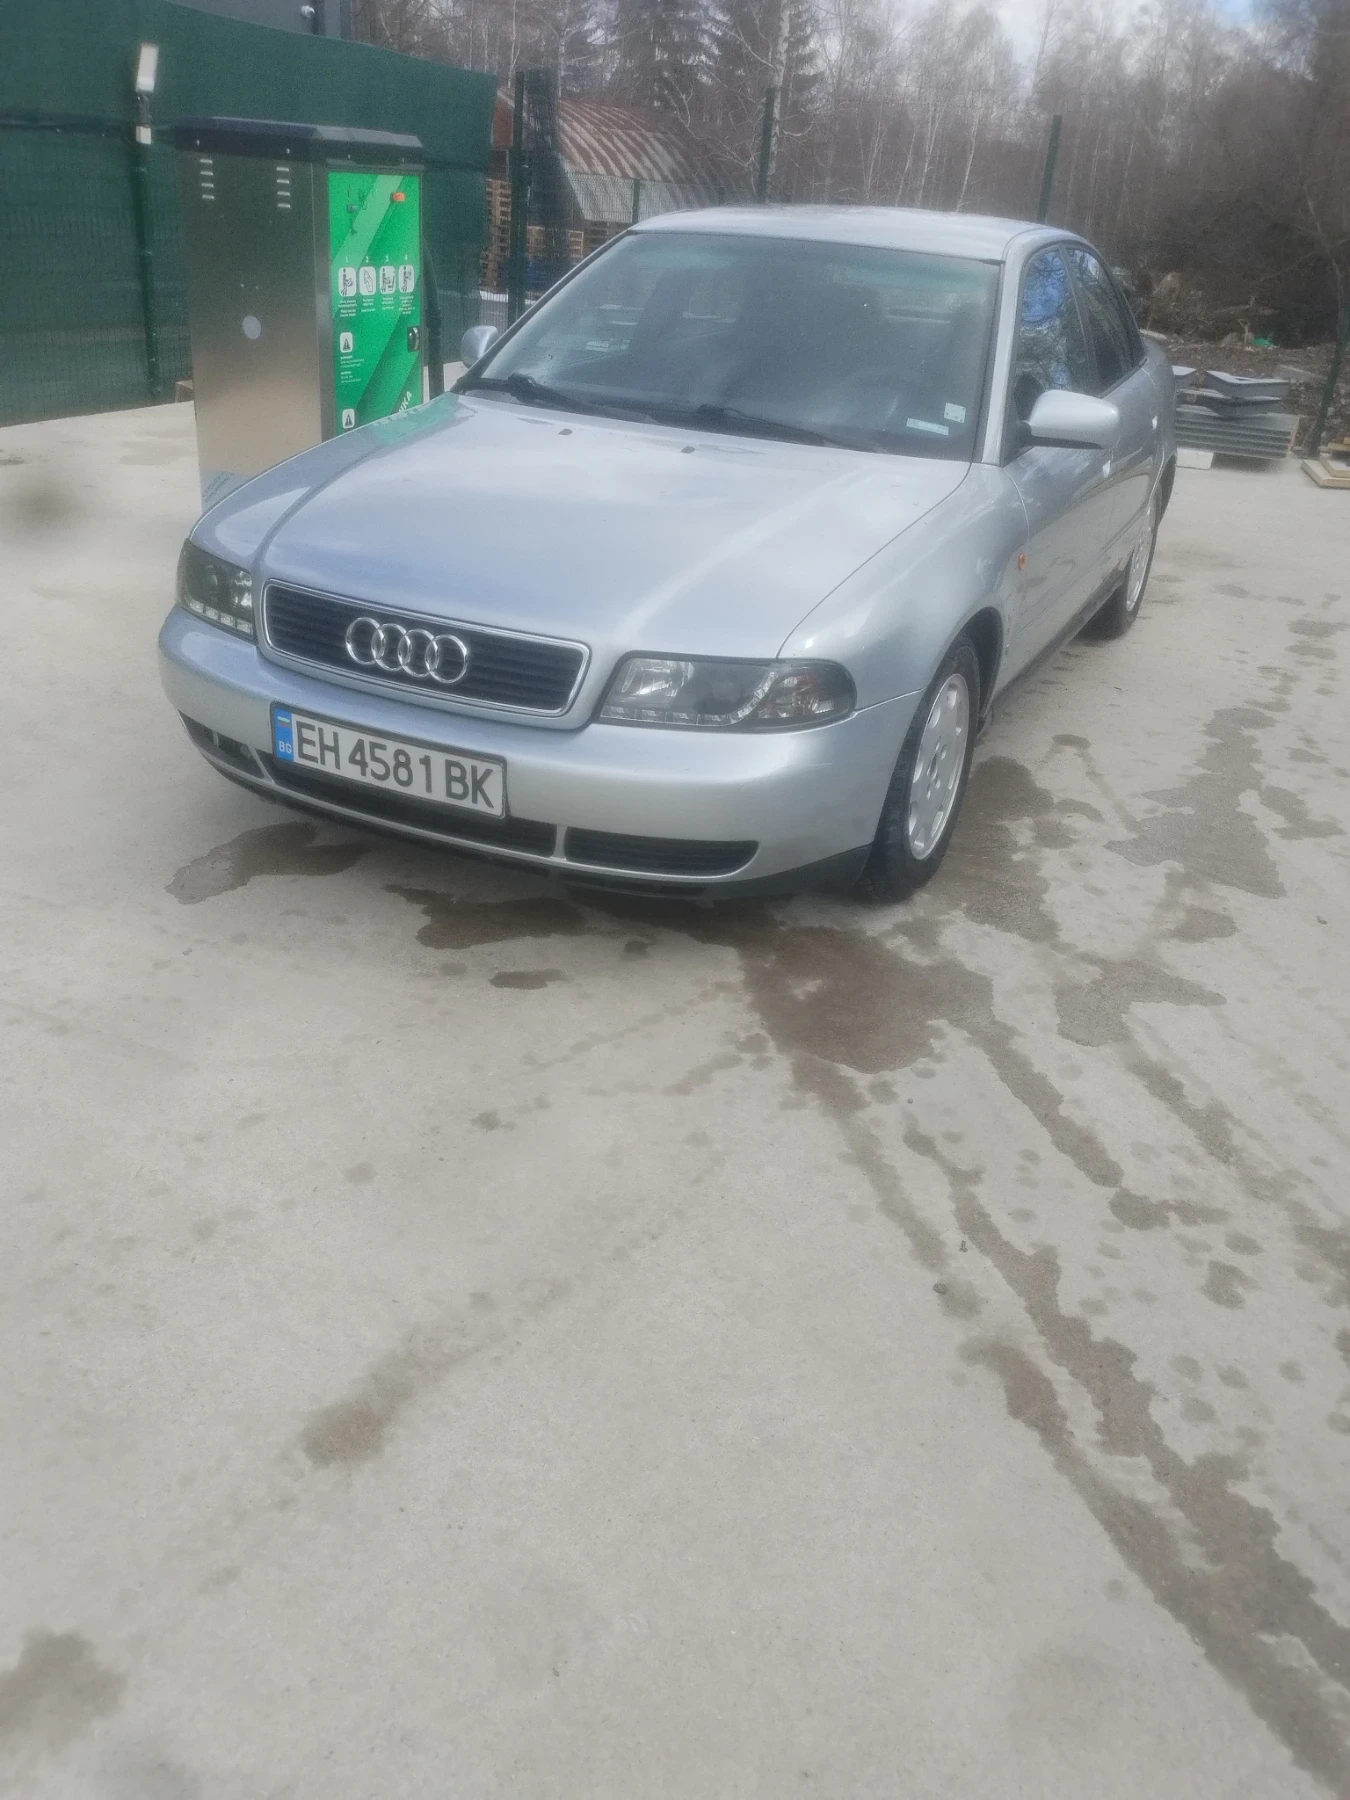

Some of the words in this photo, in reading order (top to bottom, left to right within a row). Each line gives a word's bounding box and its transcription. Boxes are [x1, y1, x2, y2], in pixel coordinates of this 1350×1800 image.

[278, 740, 292, 754] BG
[296, 720, 341, 770] EH
[348, 738, 433, 794] 4581
[445, 758, 496, 809] BK
